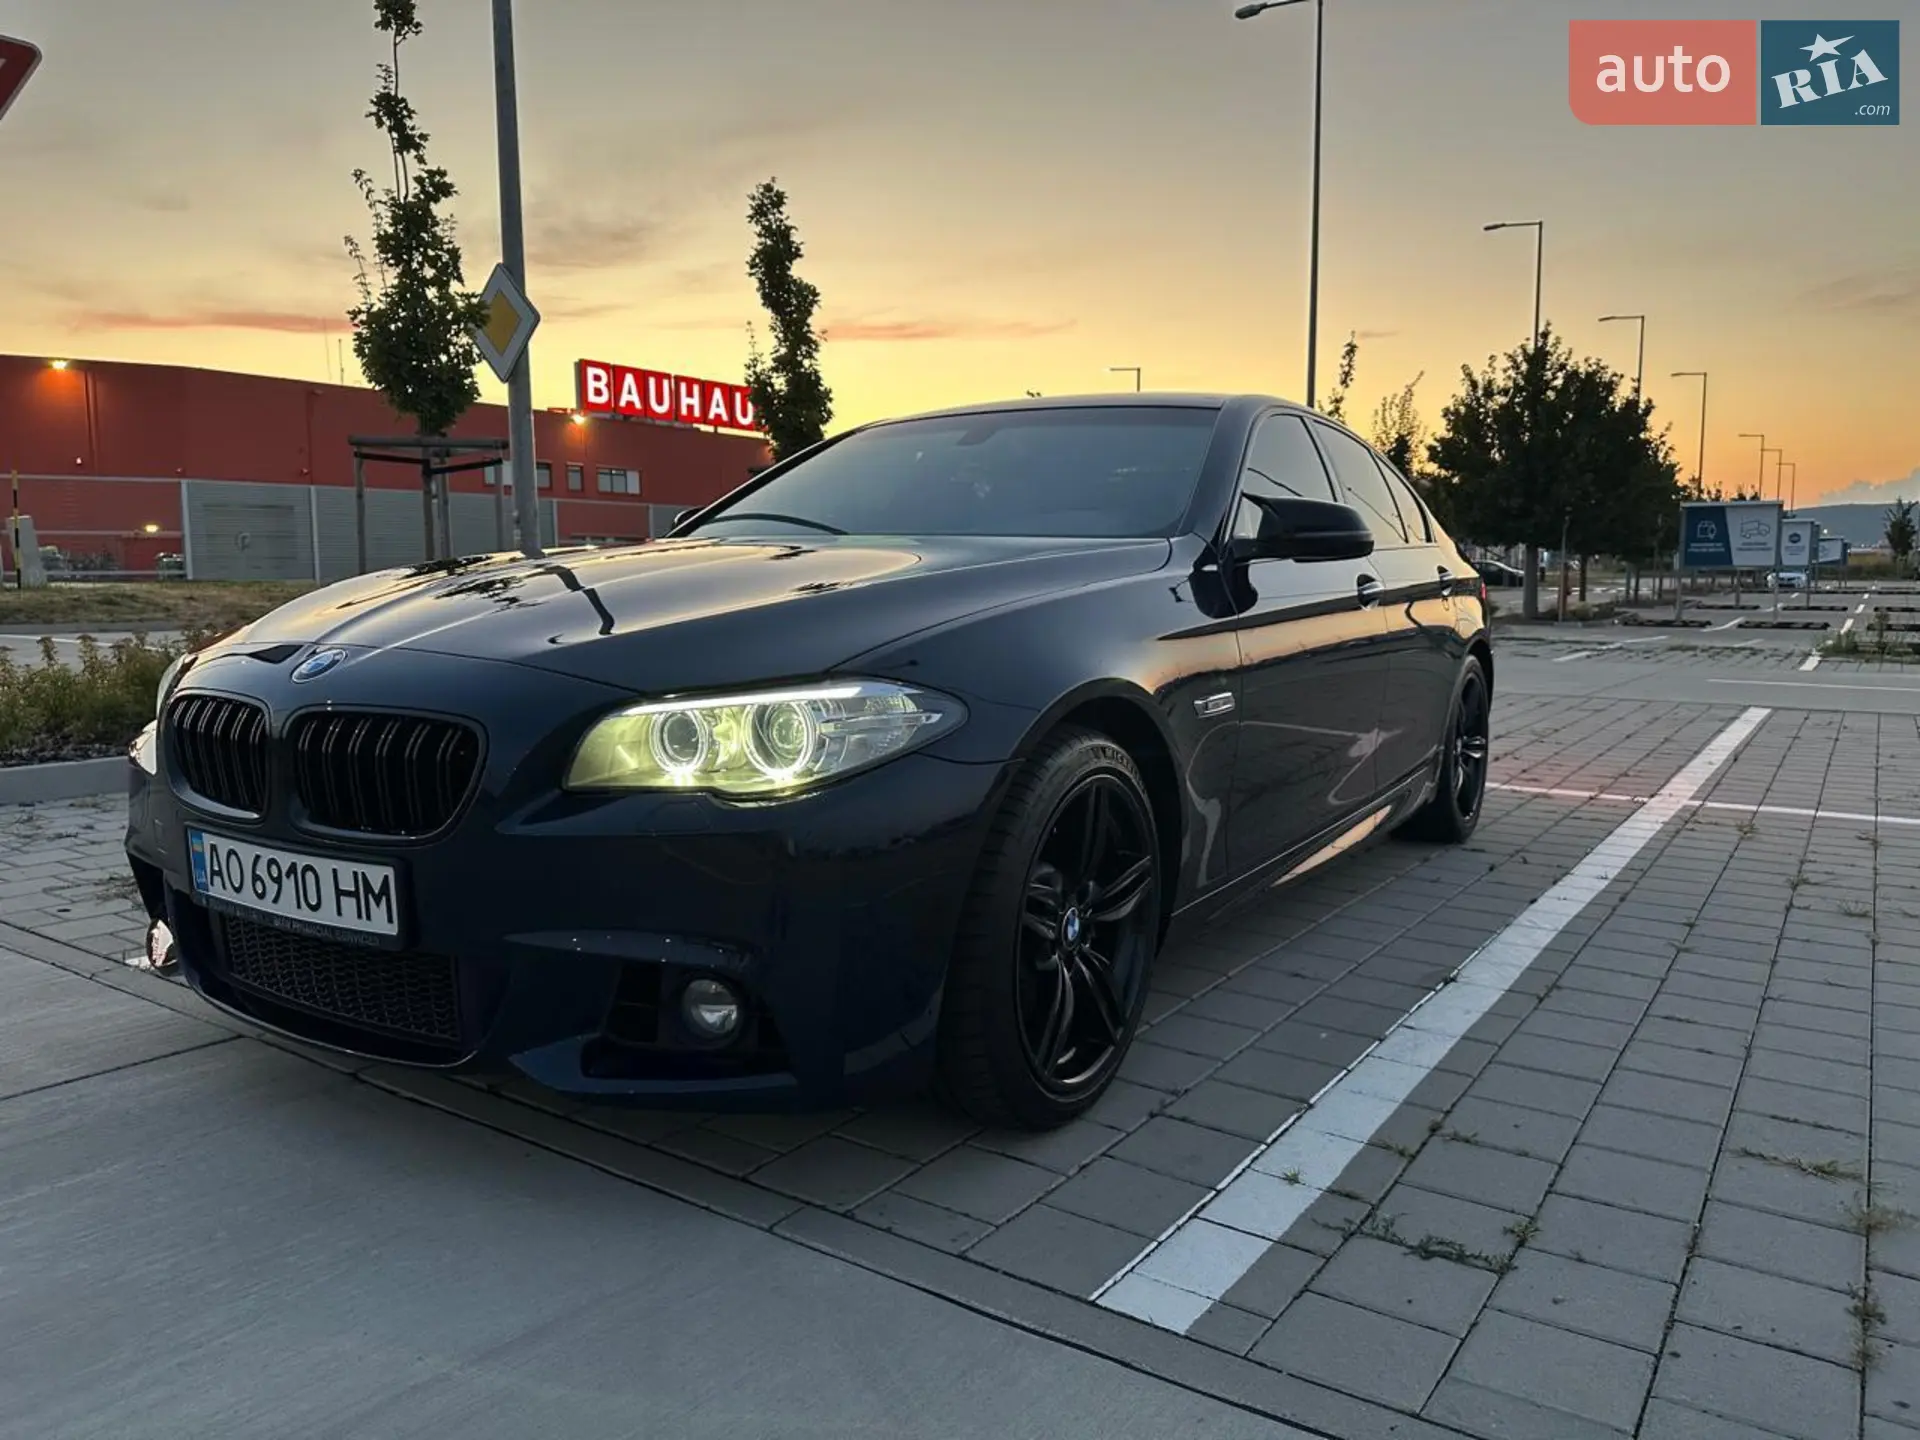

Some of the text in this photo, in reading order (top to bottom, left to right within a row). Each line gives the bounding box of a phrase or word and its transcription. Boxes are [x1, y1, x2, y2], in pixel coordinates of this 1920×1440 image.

[586, 366, 756, 426] BAUHAU
[208, 843, 245, 894] AO
[251, 853, 322, 913] 6910
[331, 867, 394, 925] HM
